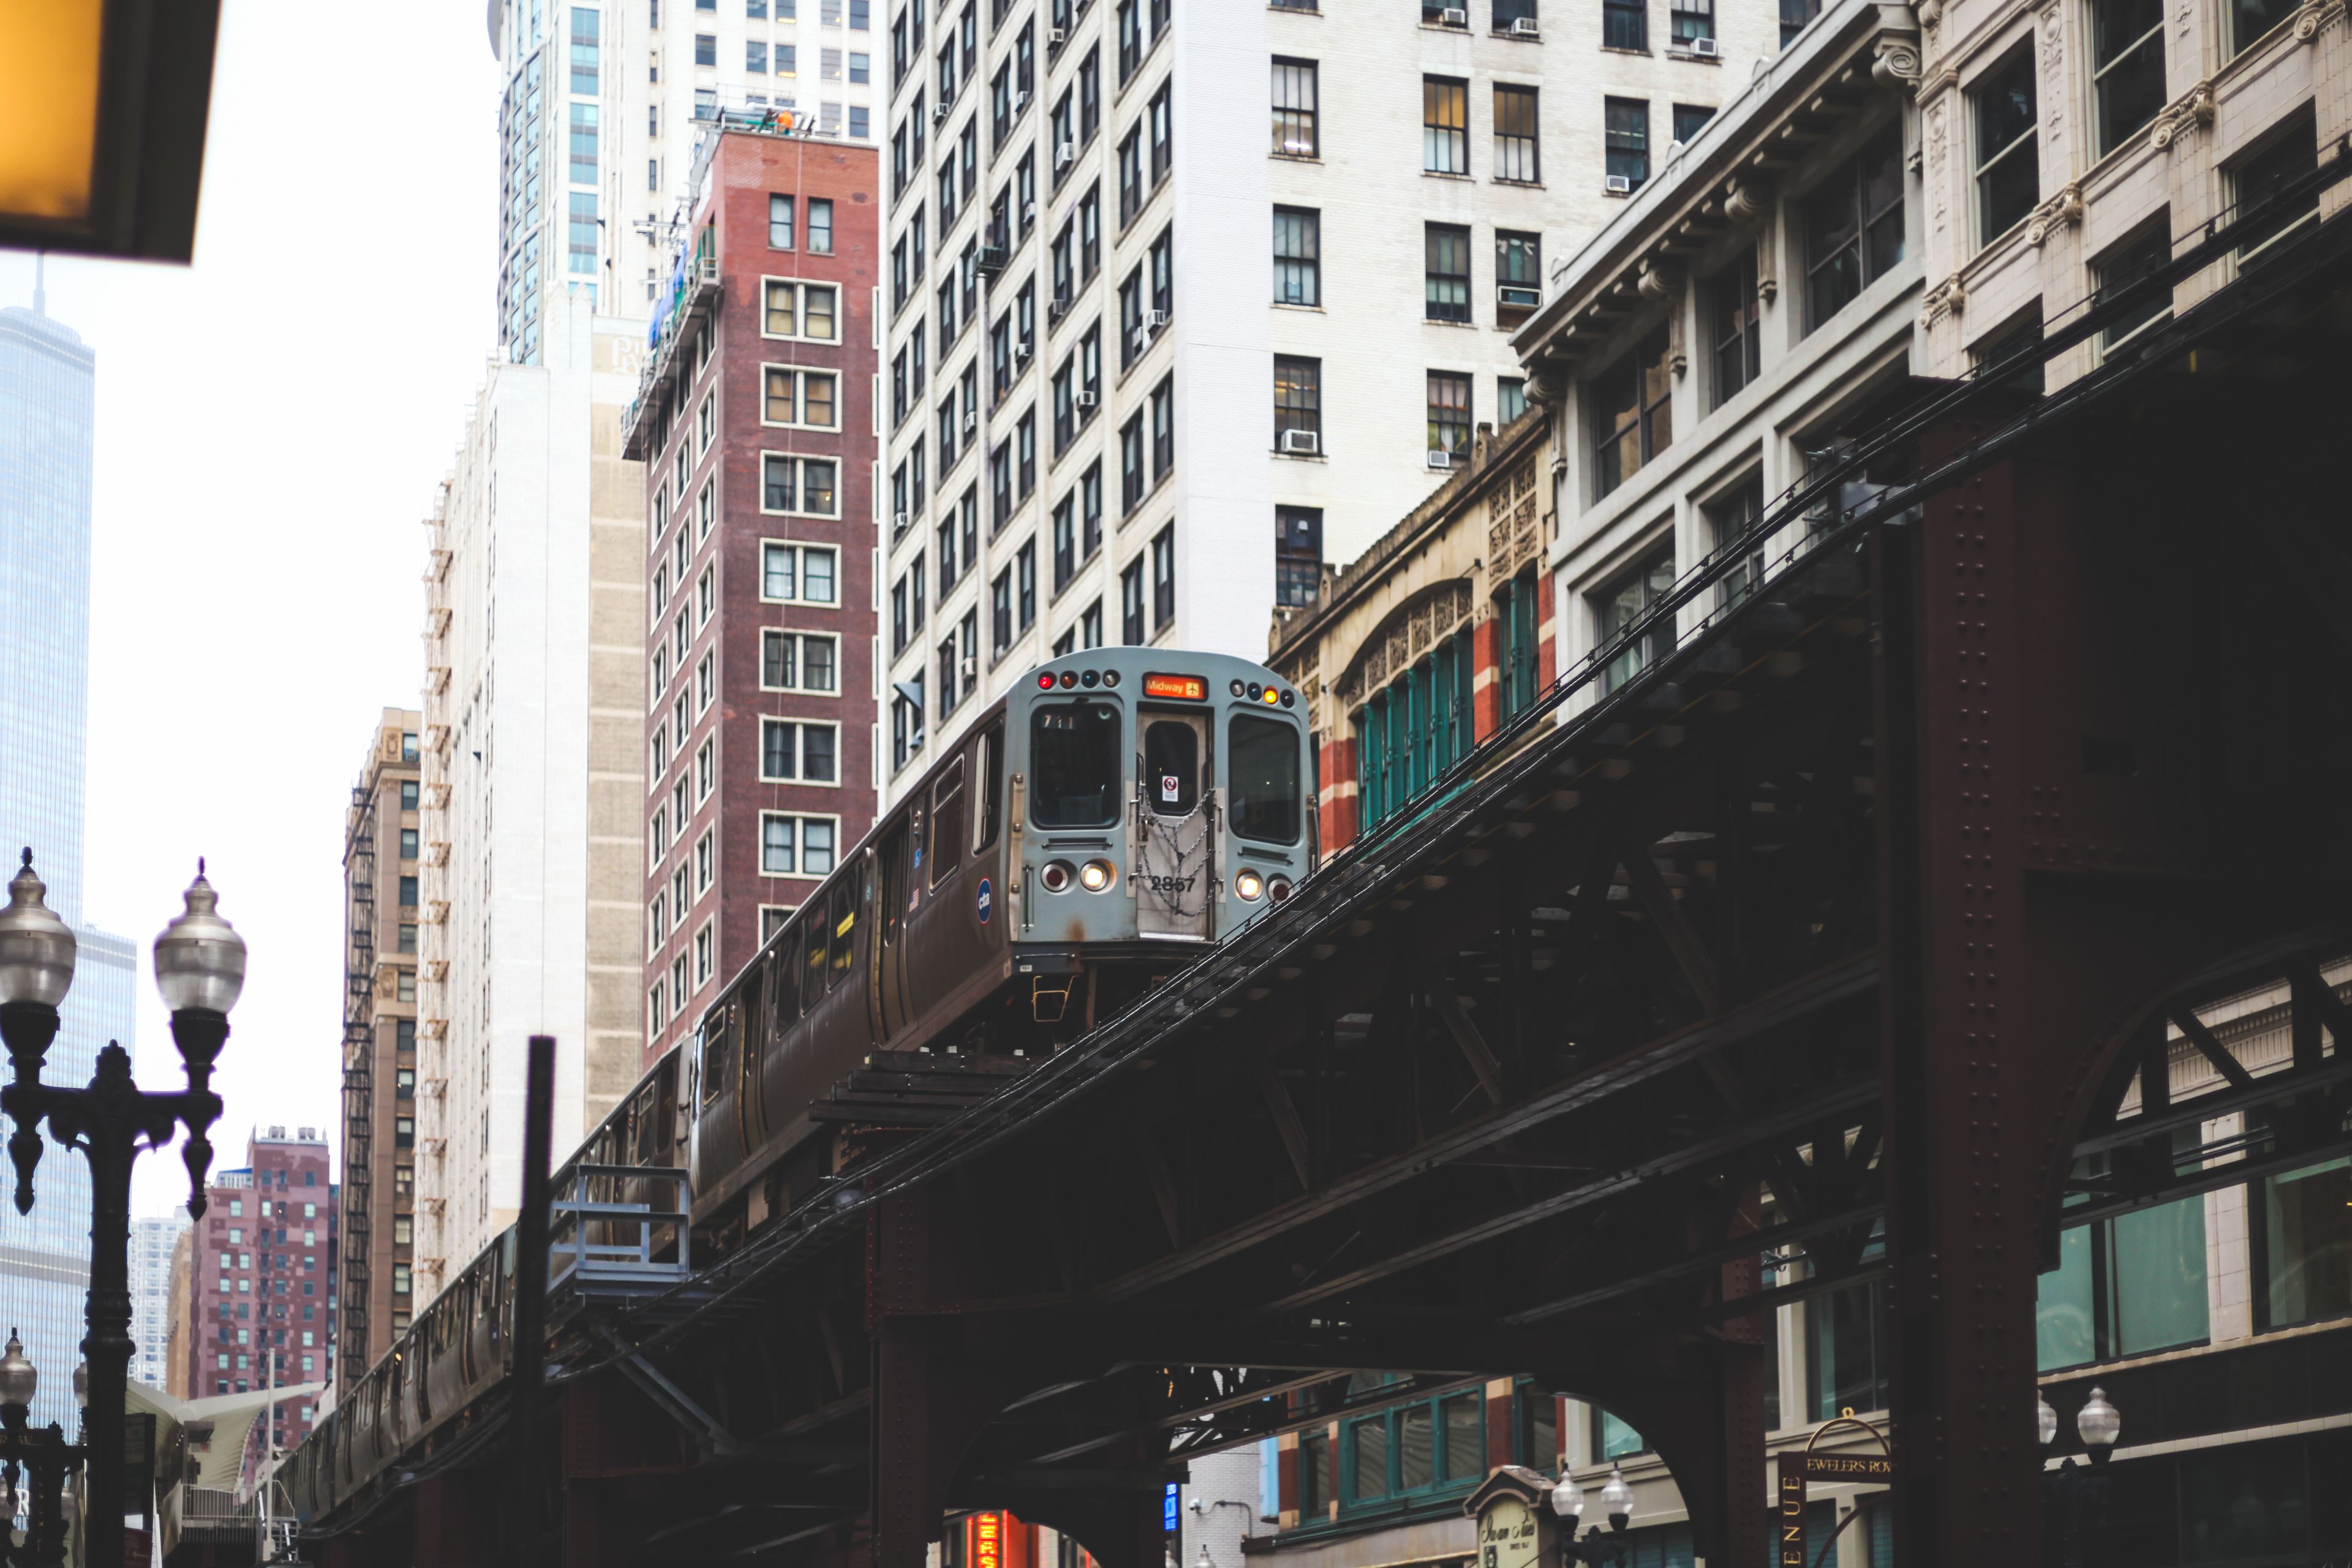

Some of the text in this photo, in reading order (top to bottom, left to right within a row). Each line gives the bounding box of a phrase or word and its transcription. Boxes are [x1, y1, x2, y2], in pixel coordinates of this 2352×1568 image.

[1146, 680, 1183, 694] Midway
[1152, 875, 1196, 892] 2857
[979, 892, 990, 910] cta
[1807, 1459, 1866, 1472] EWELERS
[1782, 1476, 1801, 1566] ENUE
